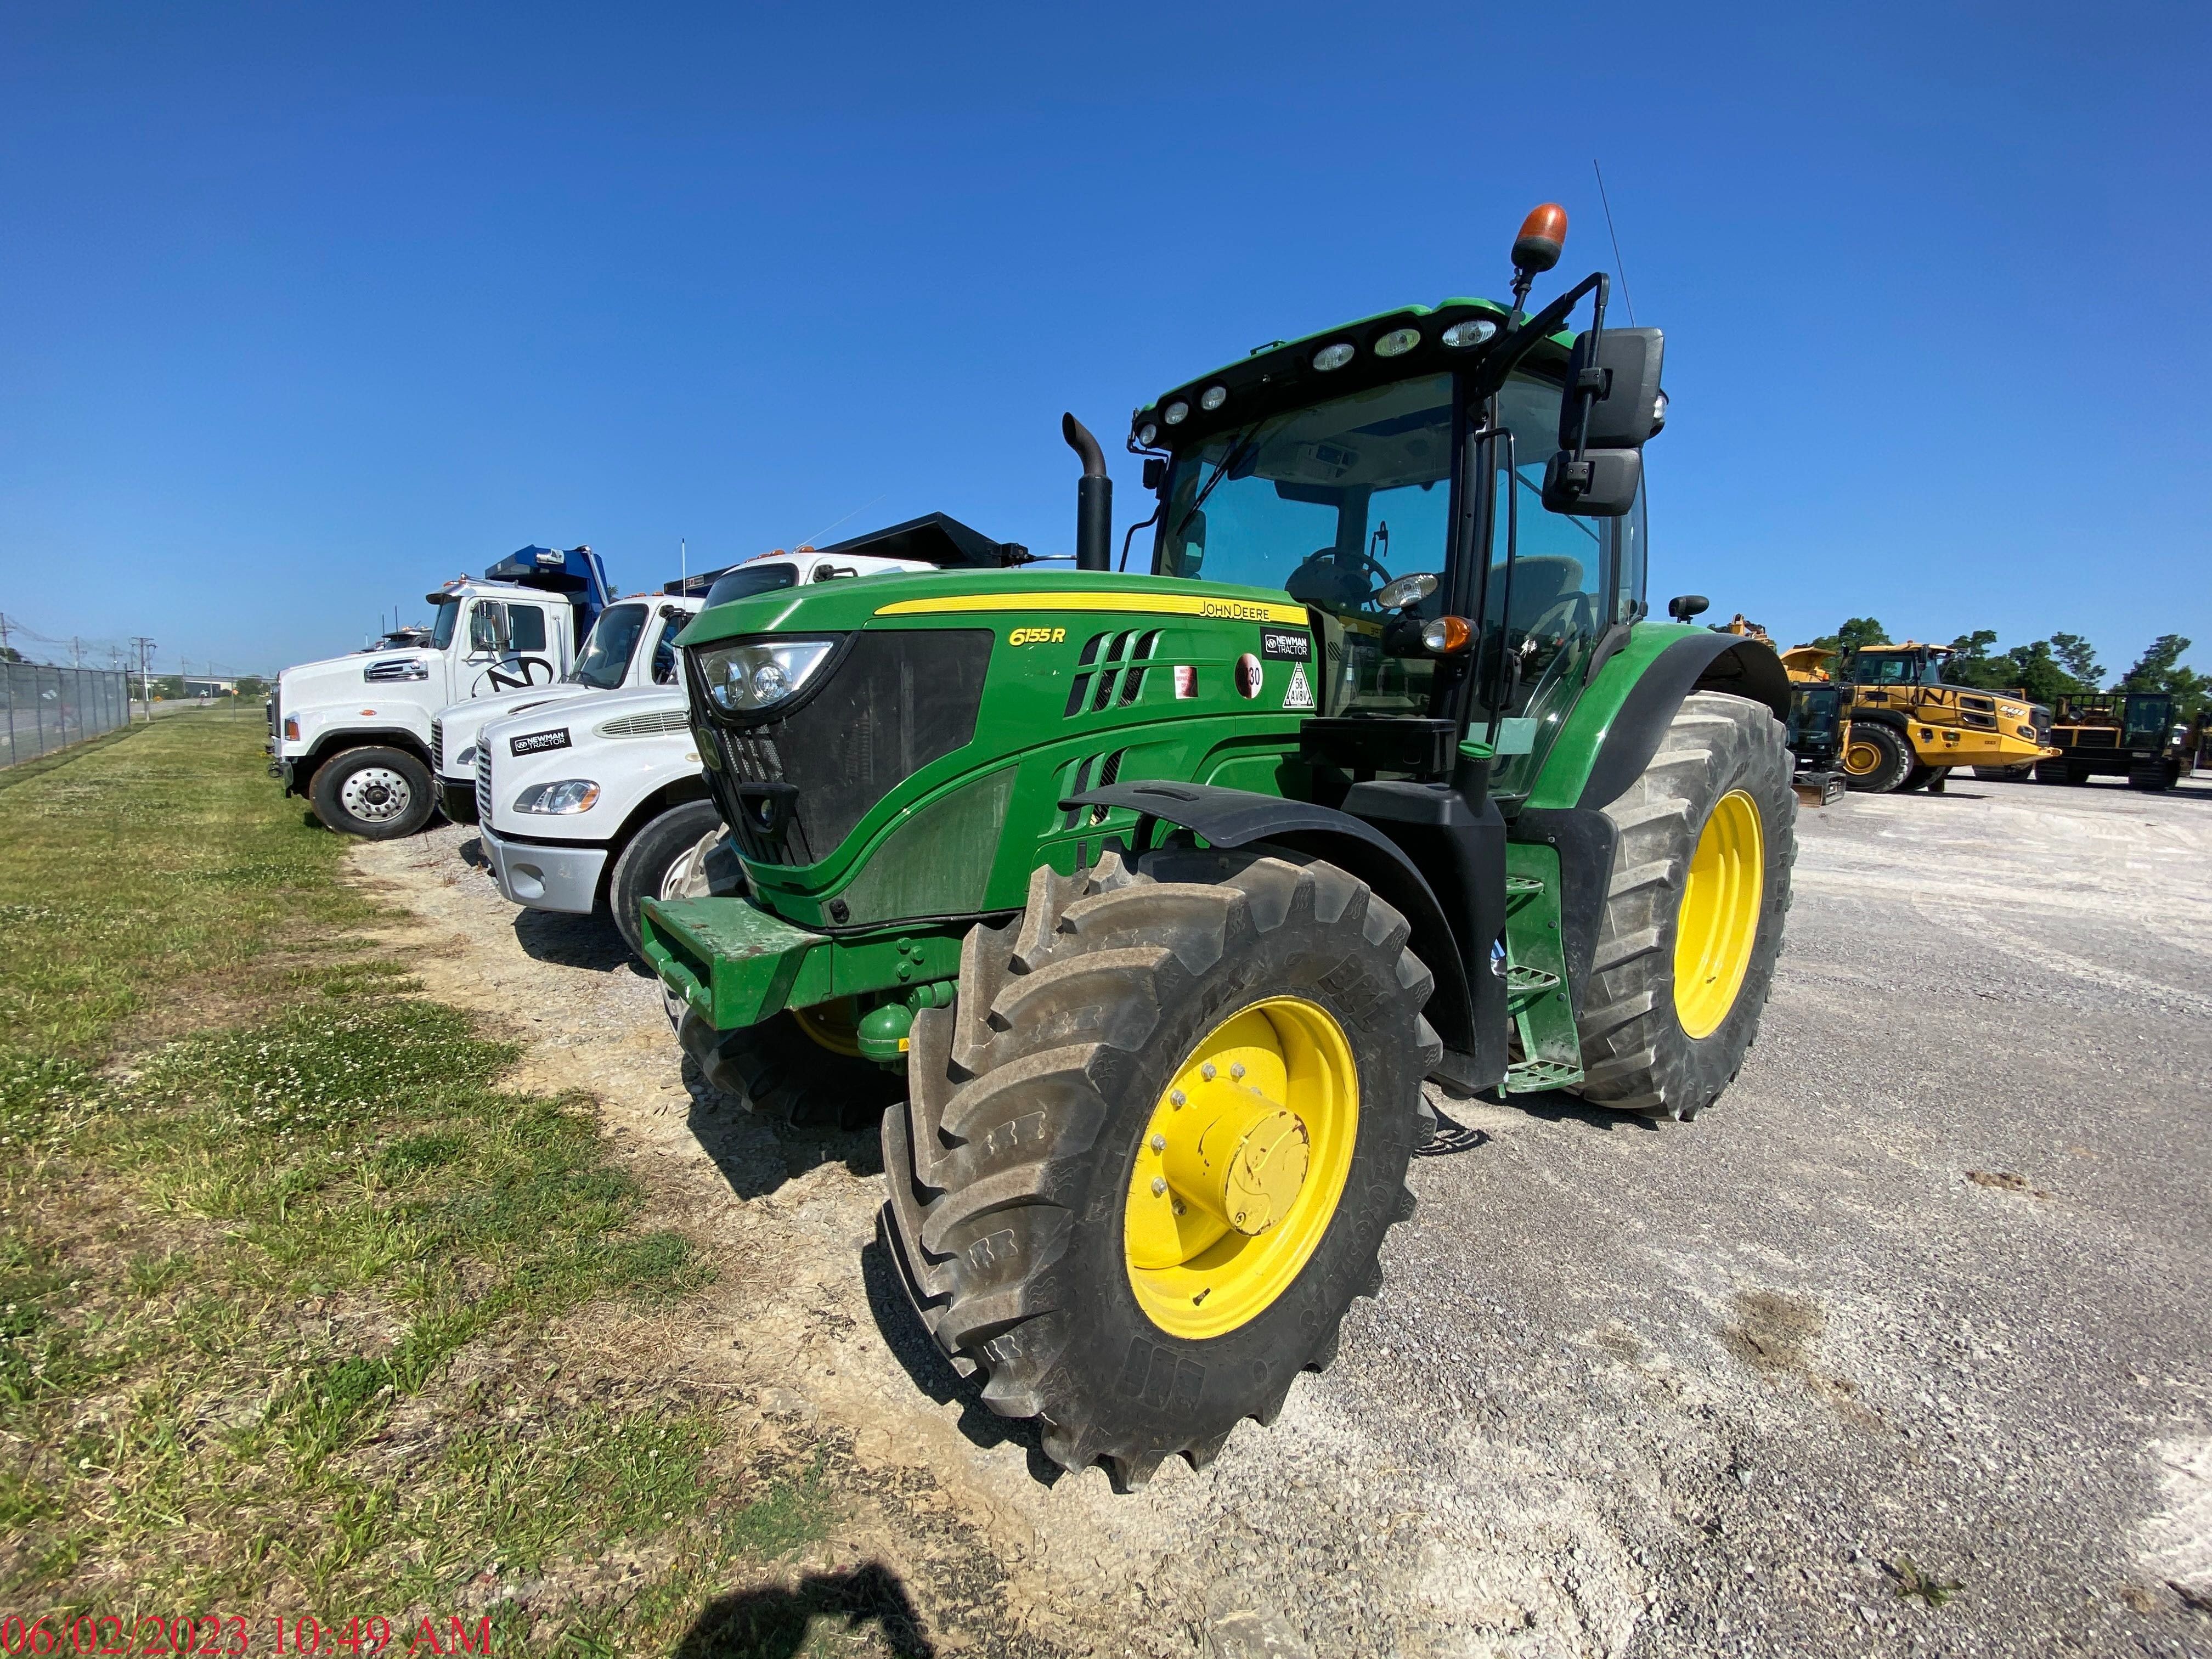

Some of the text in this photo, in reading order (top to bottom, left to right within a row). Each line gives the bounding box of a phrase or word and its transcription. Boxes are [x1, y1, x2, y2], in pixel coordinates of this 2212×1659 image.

[1199, 600, 1270, 619] JOHN DEERE
[1276, 635, 1307, 647] NEWMAN
[1277, 644, 1308, 656] TRACTOR
[1249, 667, 1260, 686] 30
[1295, 678, 1304, 689] 58
[1290, 690, 1307, 702] AV8V
[527, 731, 565, 744] NEWMAN
[528, 737, 566, 749] TRACTOR
